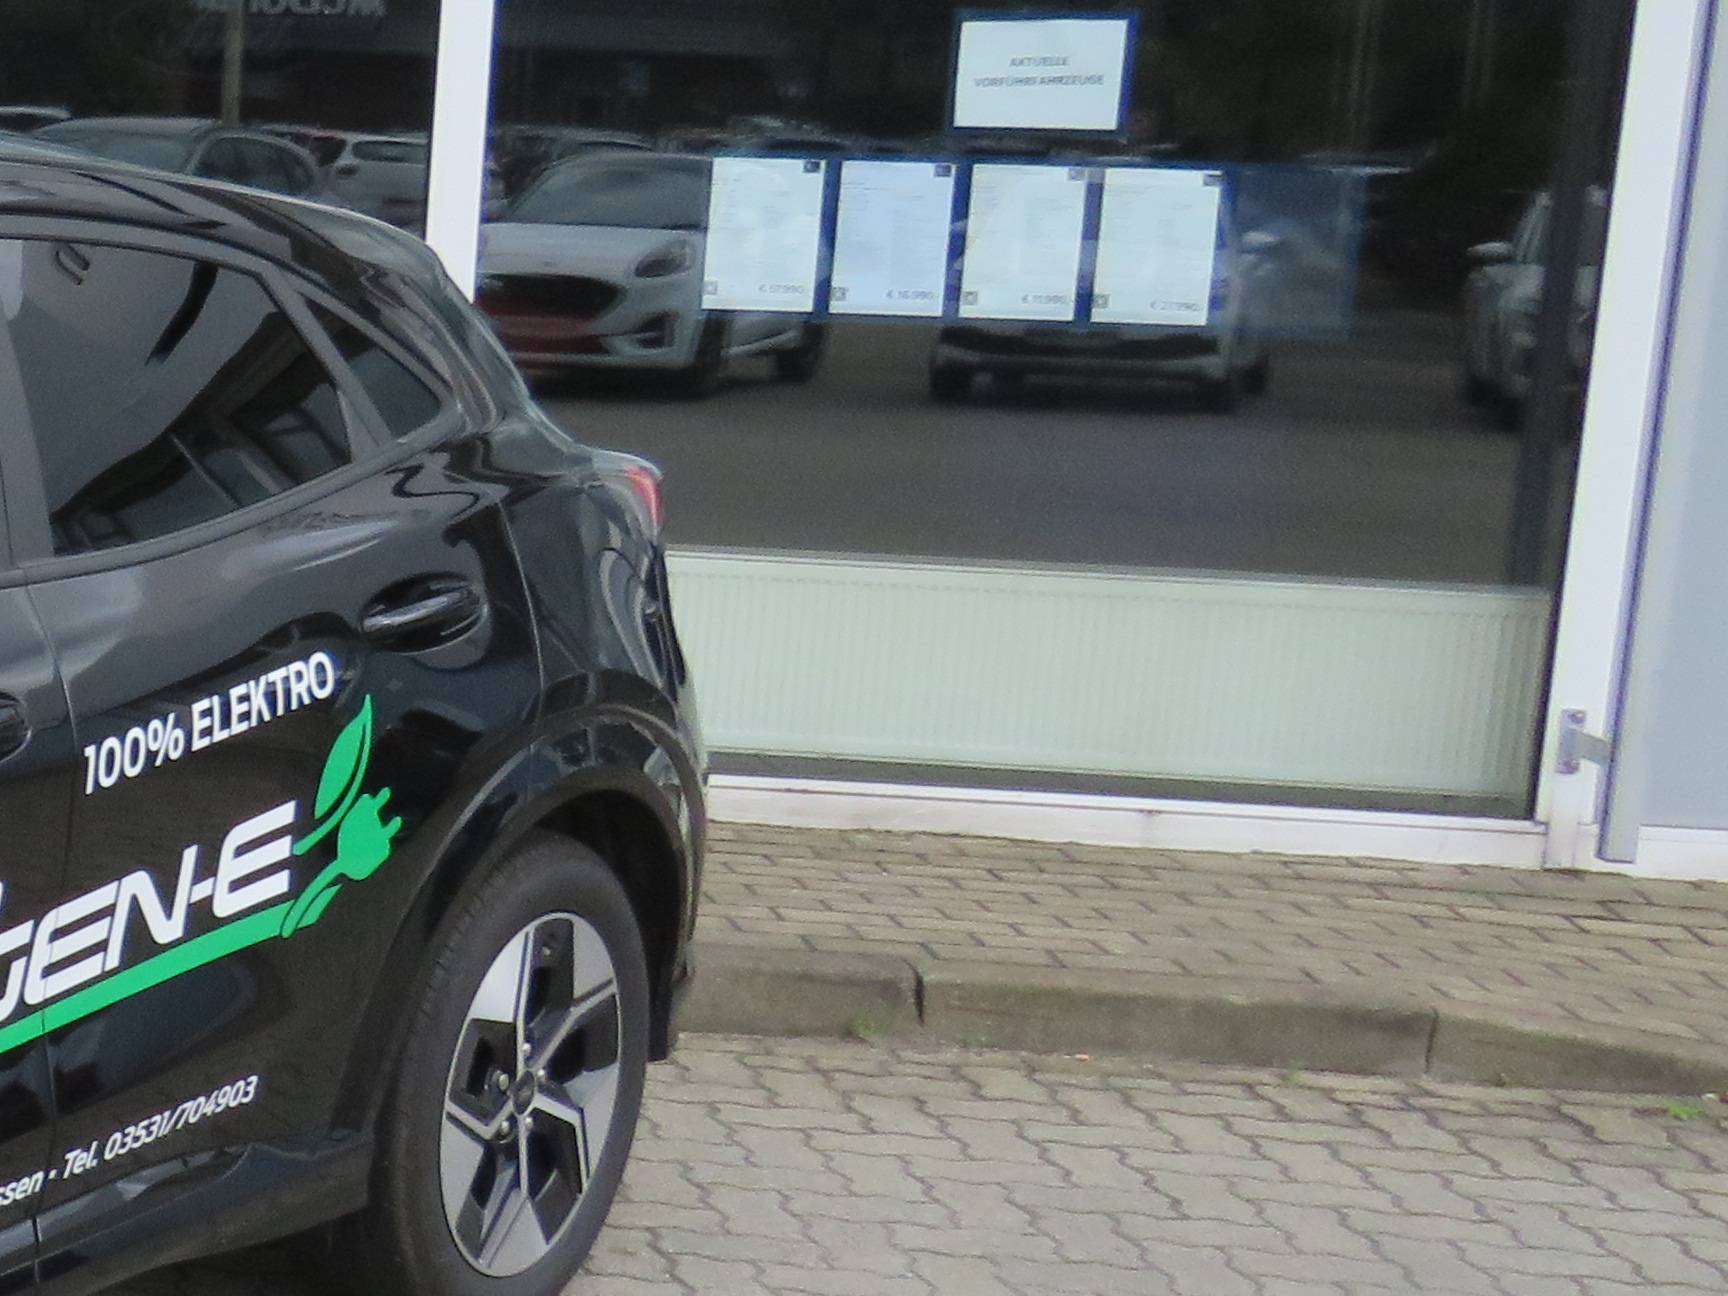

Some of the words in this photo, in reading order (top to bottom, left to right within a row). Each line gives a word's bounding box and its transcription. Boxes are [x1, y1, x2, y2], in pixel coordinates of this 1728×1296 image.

[83, 712, 185, 795] 100%
[190, 651, 335, 754] ELEKTRO
[62, 1142, 101, 1181] Tel.
[101, 1074, 260, 1163] 03531/704903
